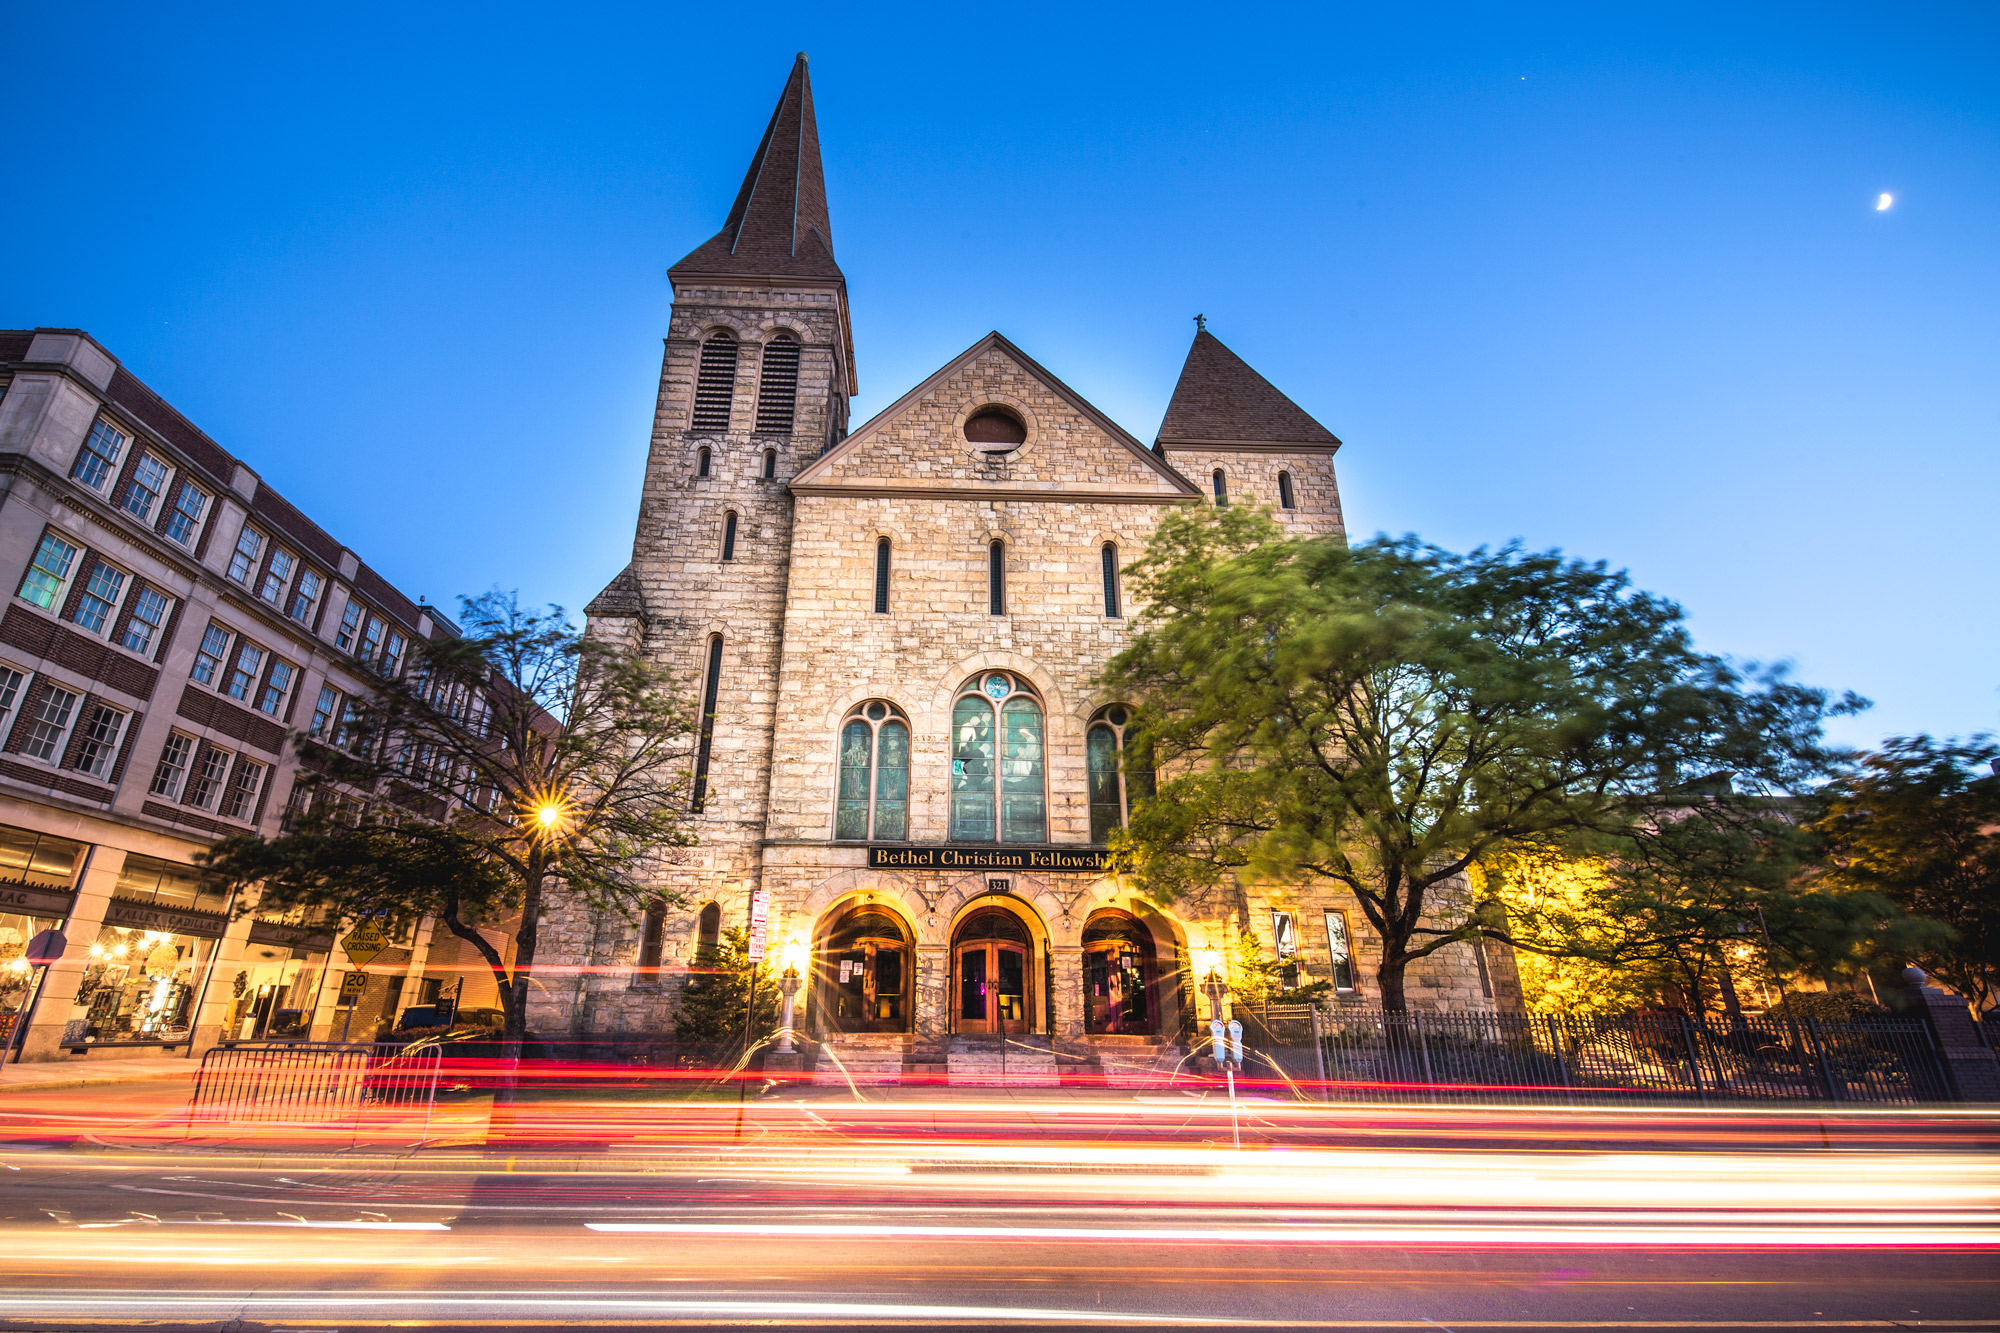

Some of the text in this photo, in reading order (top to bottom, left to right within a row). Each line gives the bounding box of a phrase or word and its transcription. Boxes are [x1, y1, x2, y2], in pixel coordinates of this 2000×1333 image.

[876, 850, 1118, 870] Bethel Christian Fellowsh
[990, 881, 1007, 890] 321
[115, 907, 220, 931] VALLEY CADILLAC
[352, 932, 380, 941] RAISED
[347, 941, 381, 952] CROSSING
[347, 974, 366, 987] 20
